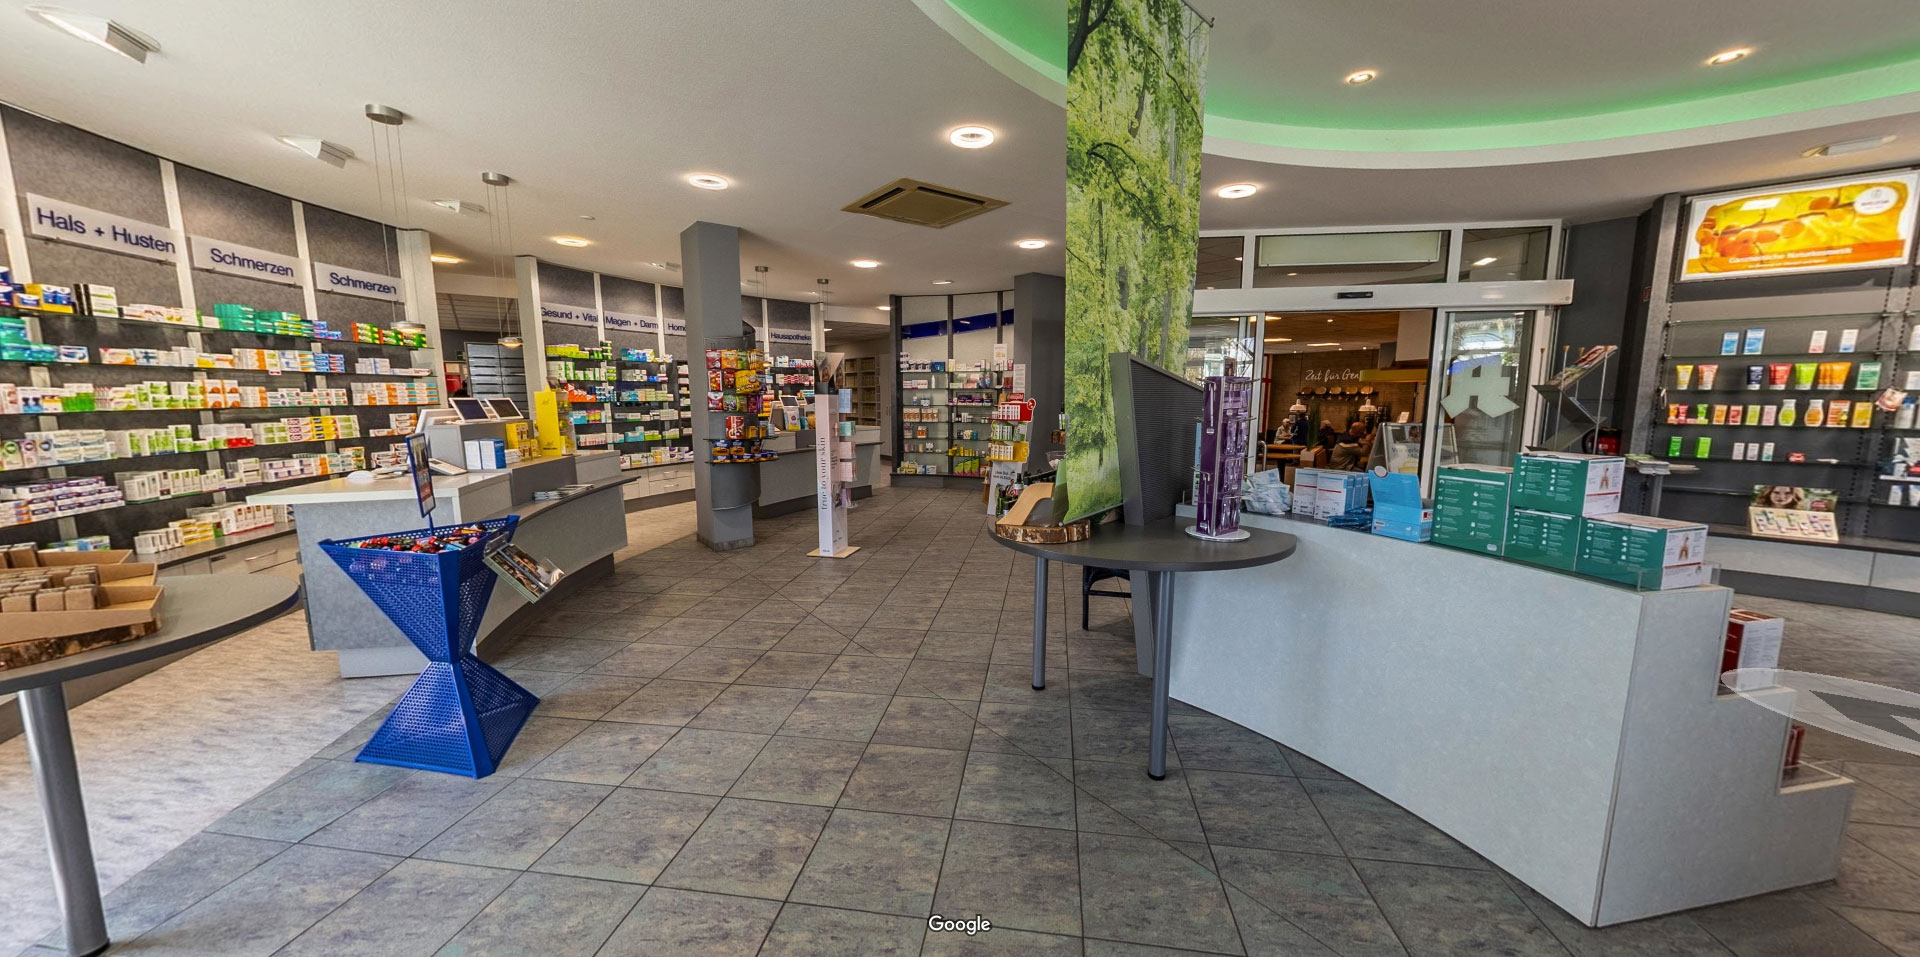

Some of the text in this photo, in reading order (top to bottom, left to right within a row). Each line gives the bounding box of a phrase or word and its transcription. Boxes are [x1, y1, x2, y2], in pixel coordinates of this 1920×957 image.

[36, 206, 177, 254] Hals + Husten
[209, 247, 294, 278] Schmerzen
[328, 271, 398, 296] Schmerzen
[540, 306, 573, 320] Gesund
[582, 312, 599, 323] Vital
[605, 315, 632, 327] Magen
[640, 319, 659, 329] Darm
[1305, 368, 1361, 383] Zeit für Gen
[818, 437, 827, 456] skin
[820, 457, 830, 479] your
